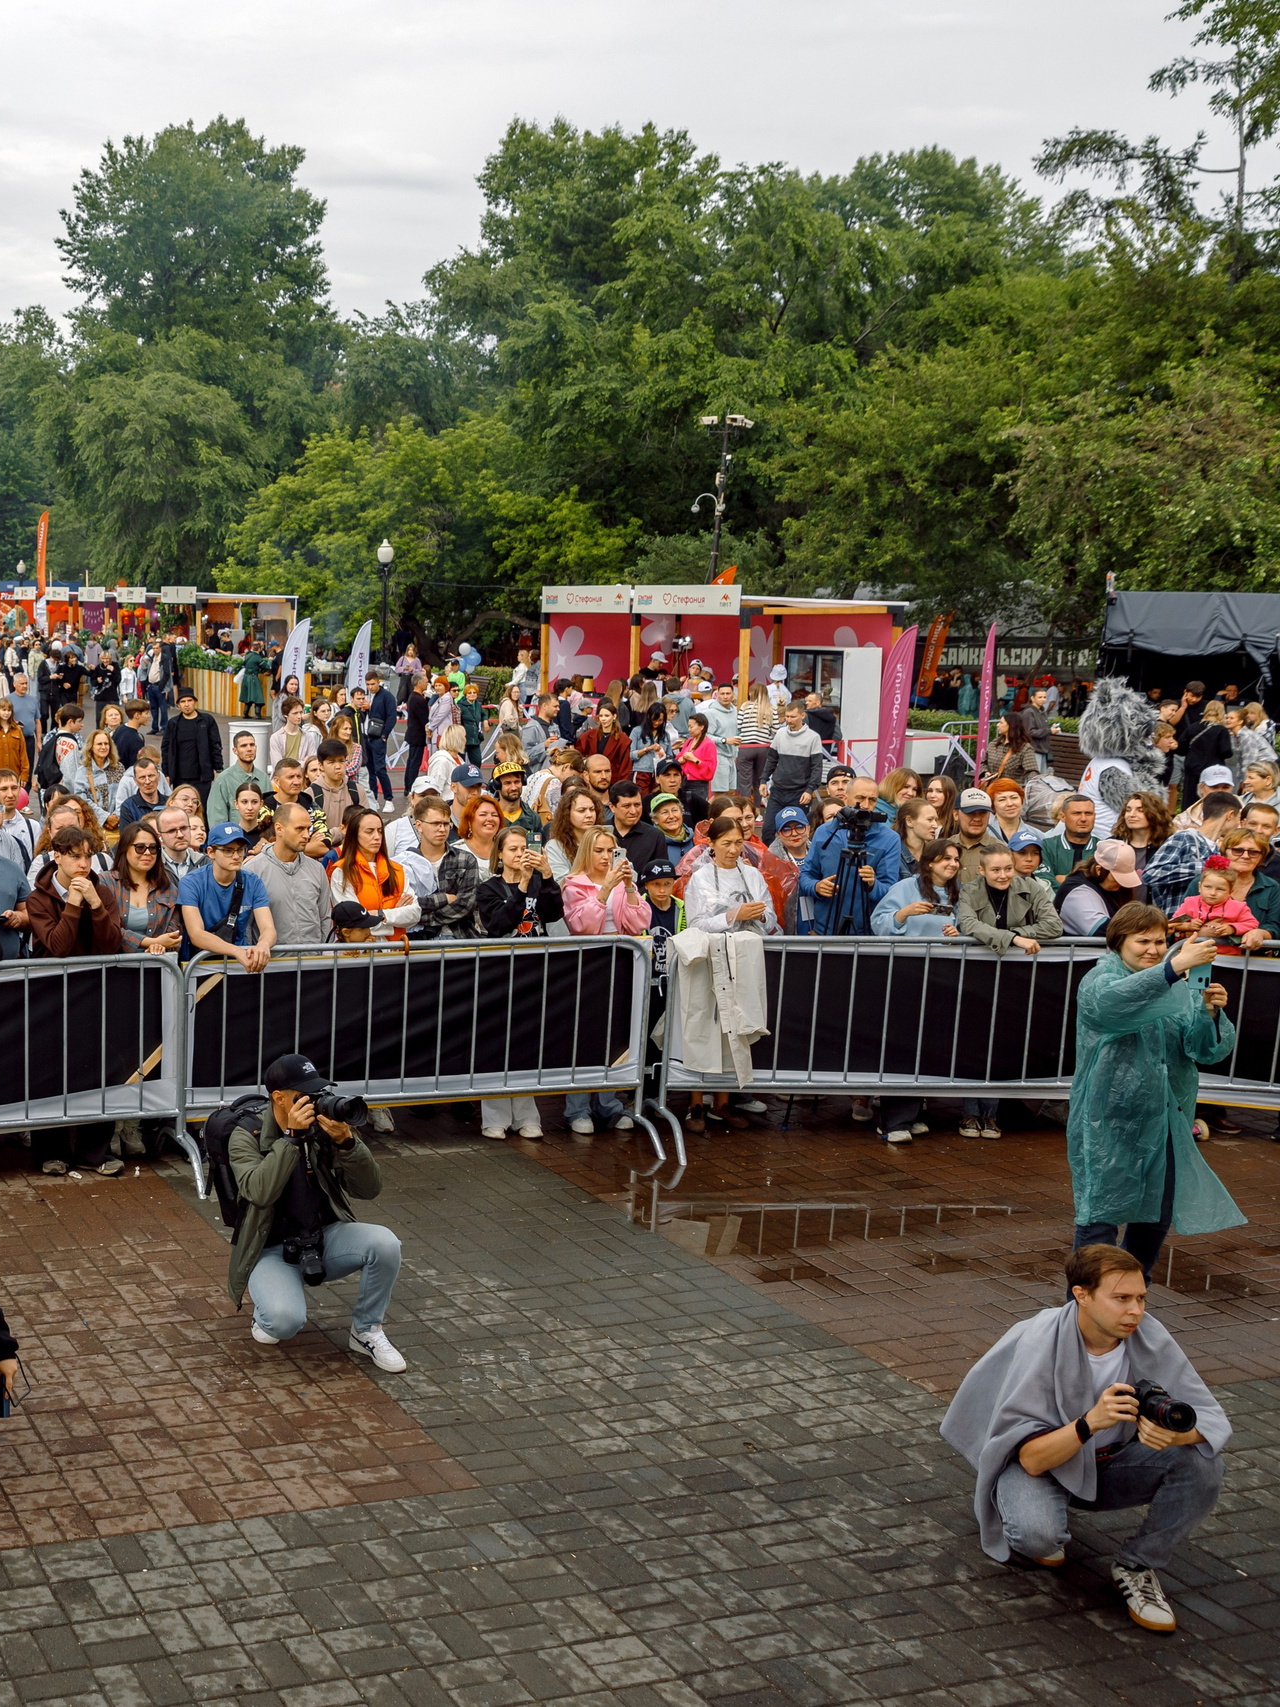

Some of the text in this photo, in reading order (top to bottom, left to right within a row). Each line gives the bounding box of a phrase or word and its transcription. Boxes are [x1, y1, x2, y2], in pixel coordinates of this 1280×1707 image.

[0, 592, 14, 600] Pizz
[574, 594, 602, 605] Стефания
[672, 594, 706, 606] Стефания
